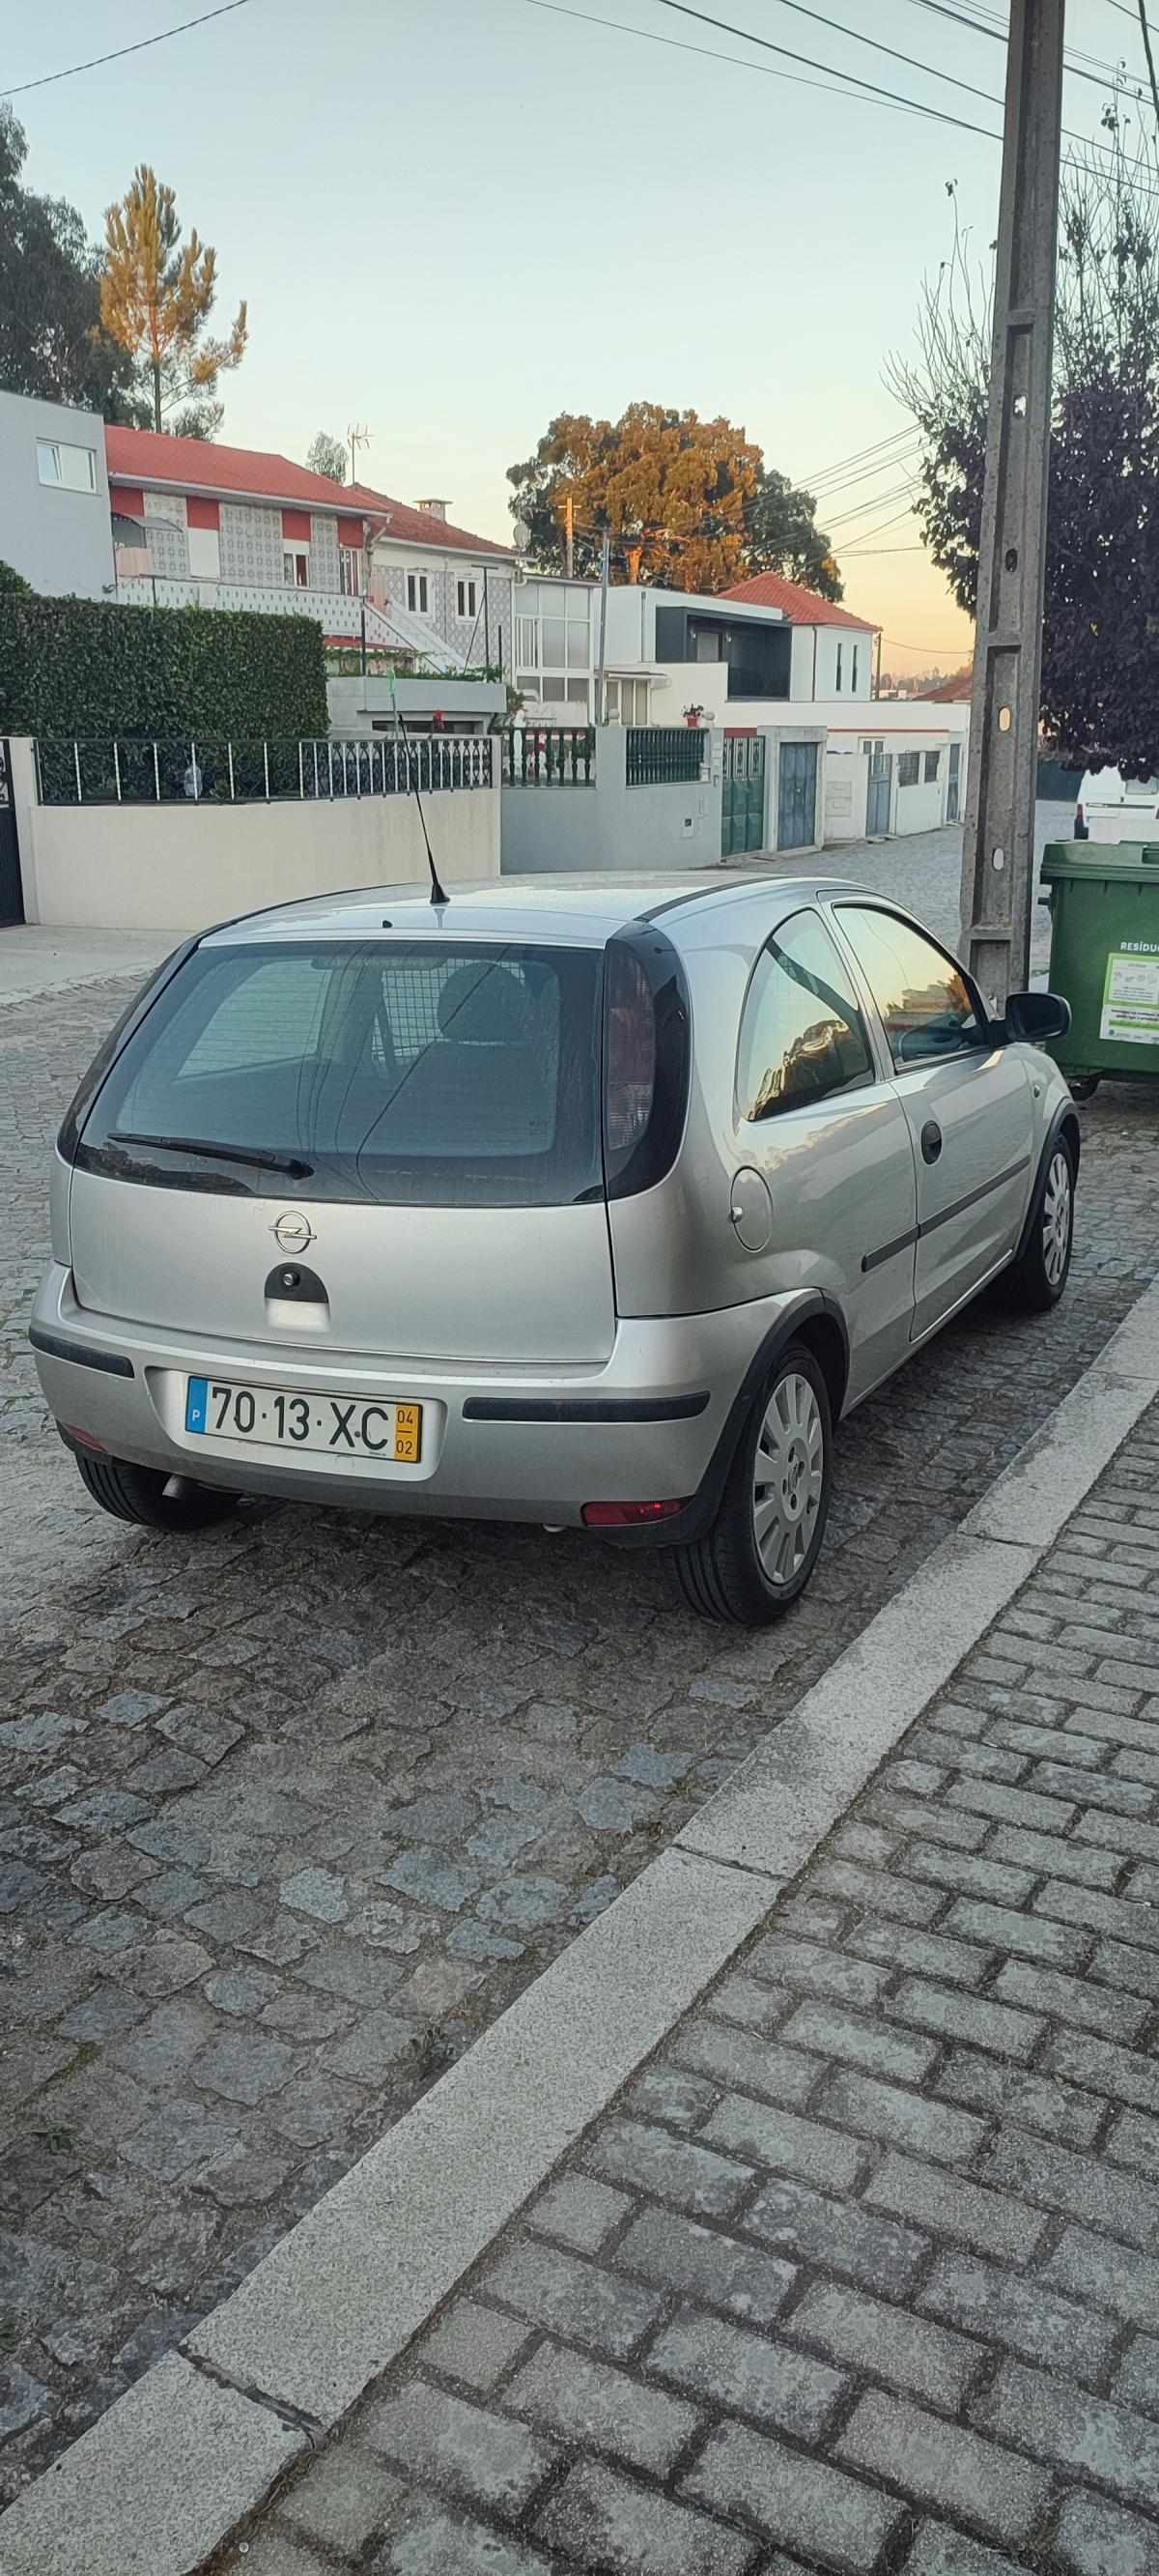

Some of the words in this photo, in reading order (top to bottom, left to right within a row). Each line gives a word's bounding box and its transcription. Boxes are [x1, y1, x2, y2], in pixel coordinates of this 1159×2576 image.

[1120, 940, 1159, 952] RESÍDU
[192, 1409, 200, 1421] P
[397, 1409, 413, 1424] 04
[396, 1440, 412, 1455] 02
